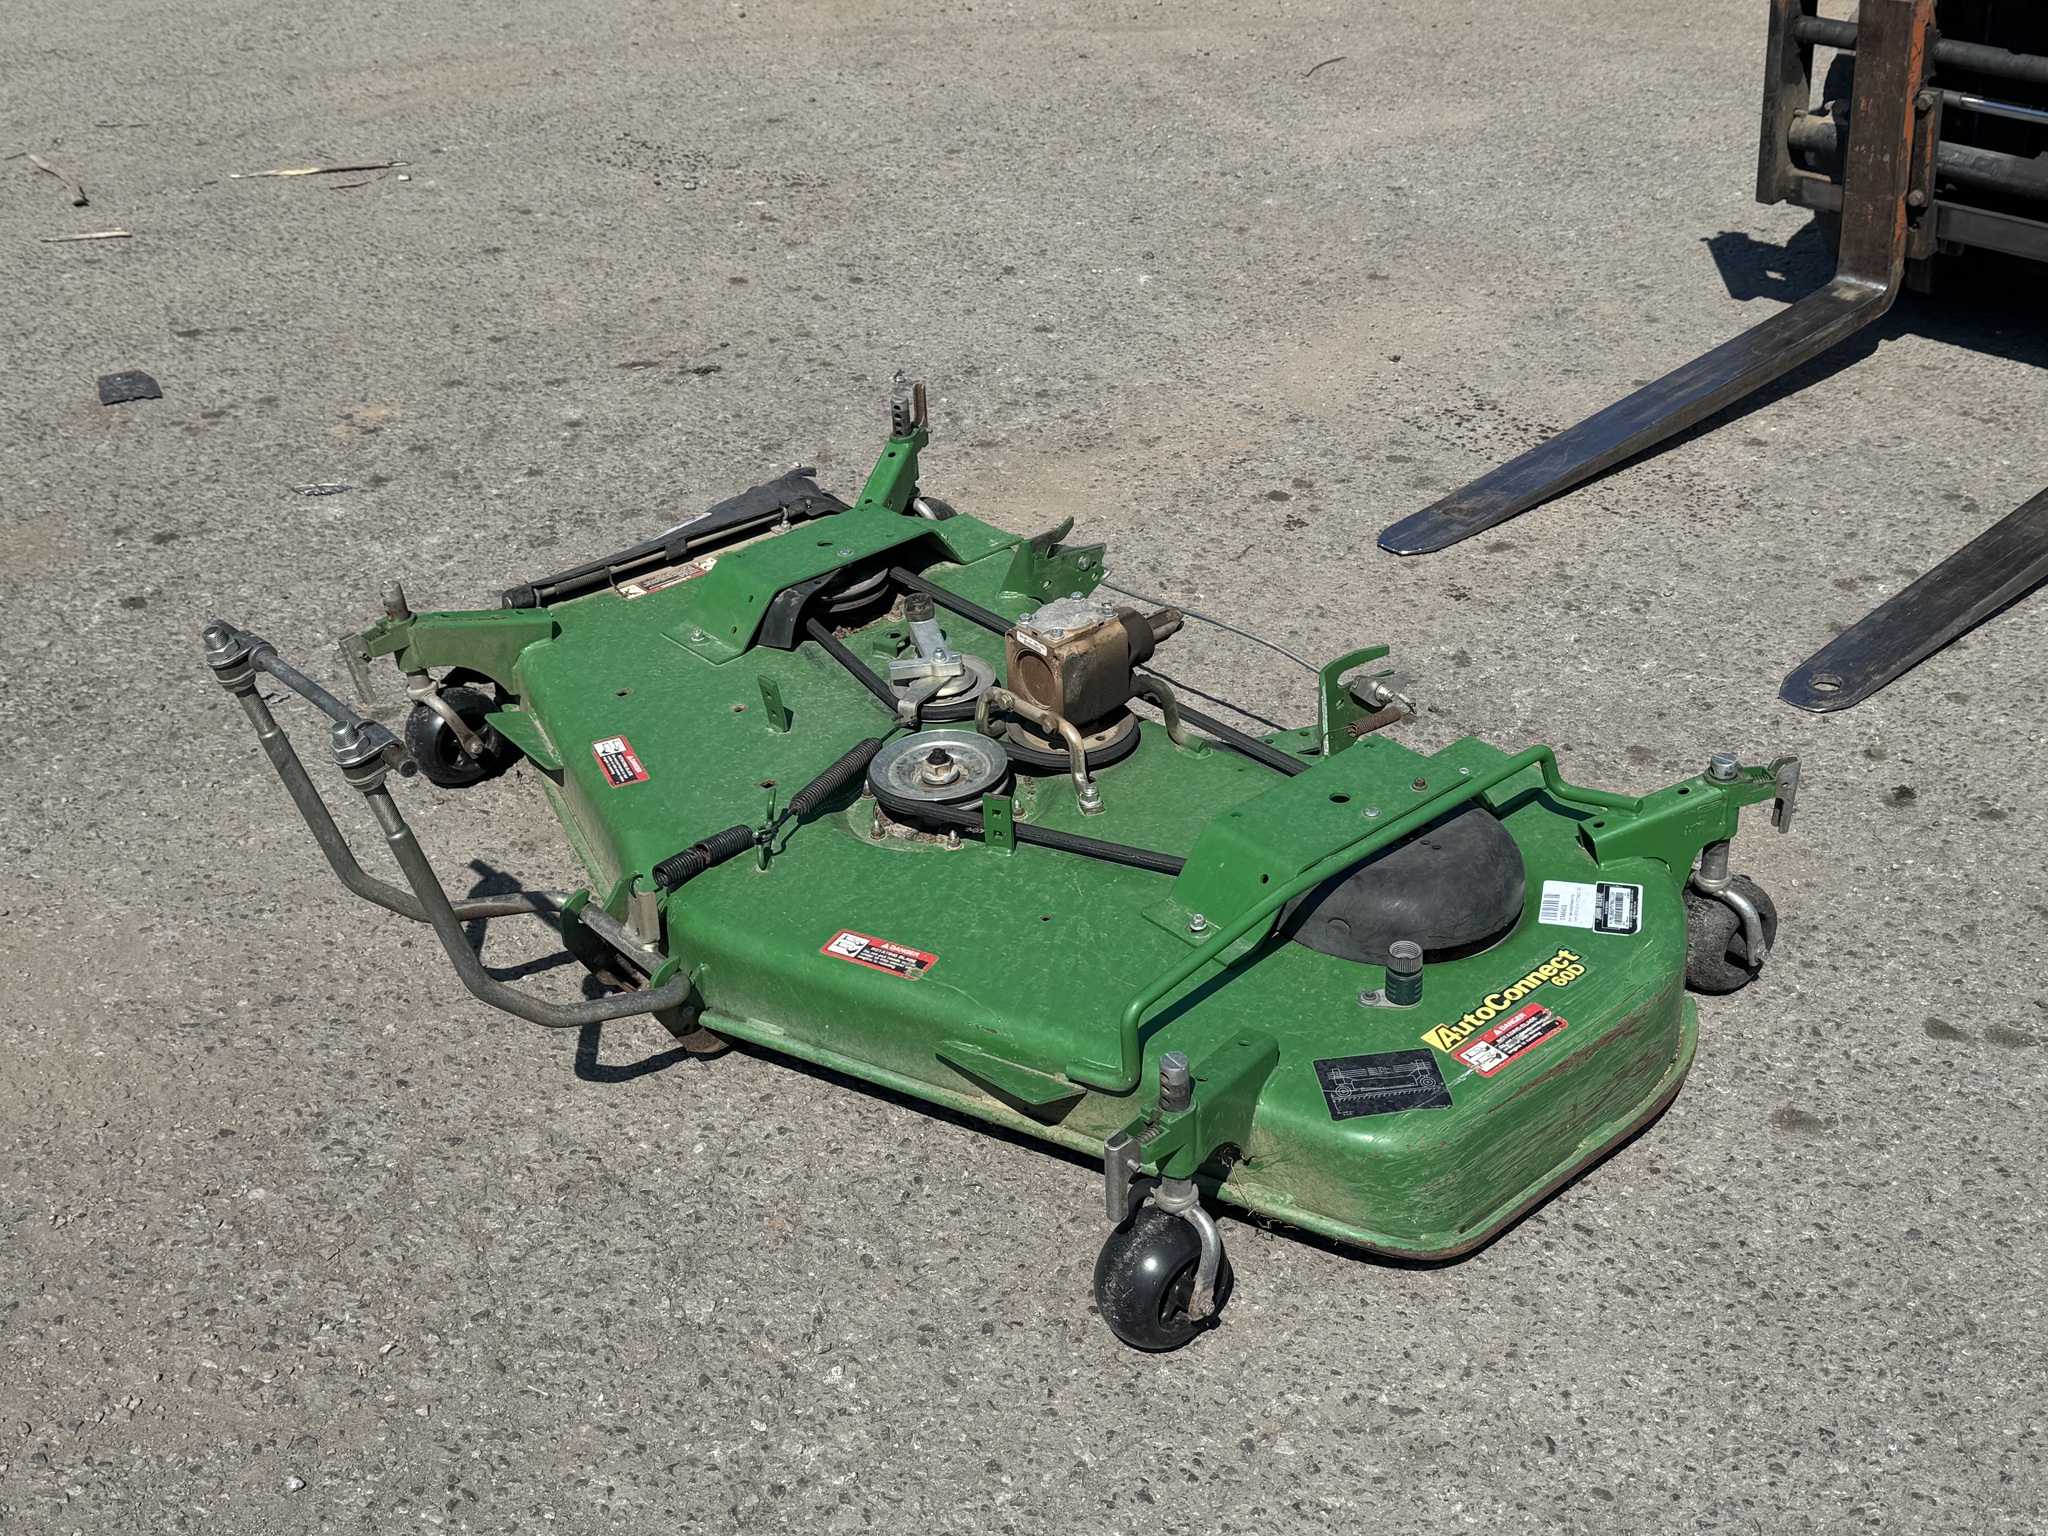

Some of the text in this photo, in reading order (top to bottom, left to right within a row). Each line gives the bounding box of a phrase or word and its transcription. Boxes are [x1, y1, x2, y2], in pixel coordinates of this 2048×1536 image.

[889, 944, 921, 957] DANGER
[1551, 963, 1586, 987] 60D
[1436, 949, 1580, 1050] AutoConnect
[1499, 1012, 1527, 1031] DANGER
